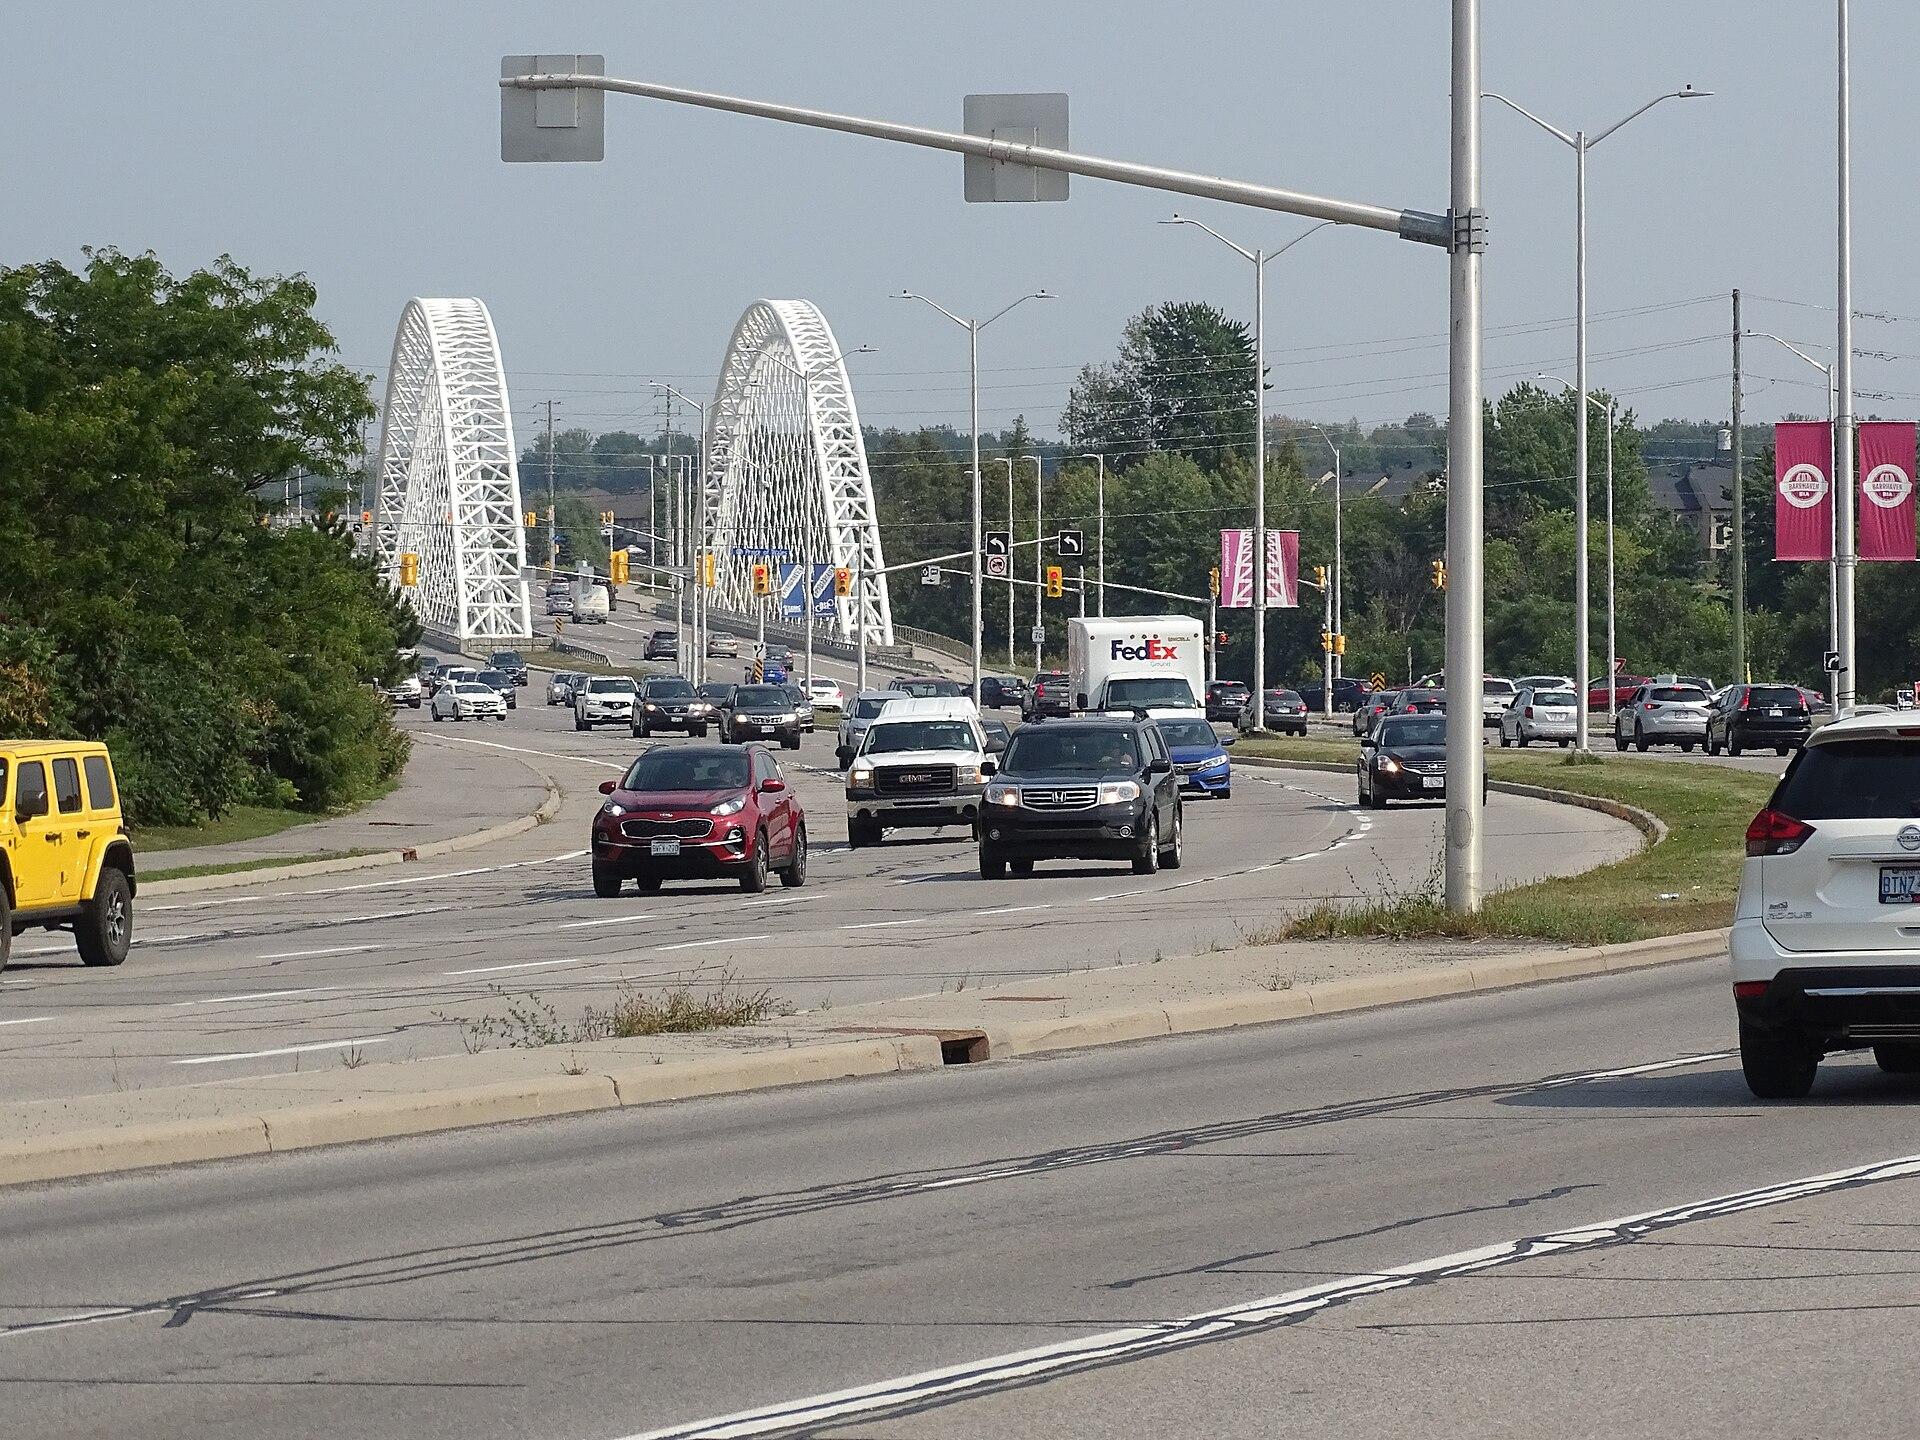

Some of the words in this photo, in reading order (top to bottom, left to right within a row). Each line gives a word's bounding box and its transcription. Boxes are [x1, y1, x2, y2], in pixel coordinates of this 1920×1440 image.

[1788, 483, 1820, 491] BARRHAVEN
[1872, 483, 1903, 491] BARRHAVEN
[1111, 639, 1178, 661] FedEx
[899, 774, 932, 784] GMC
